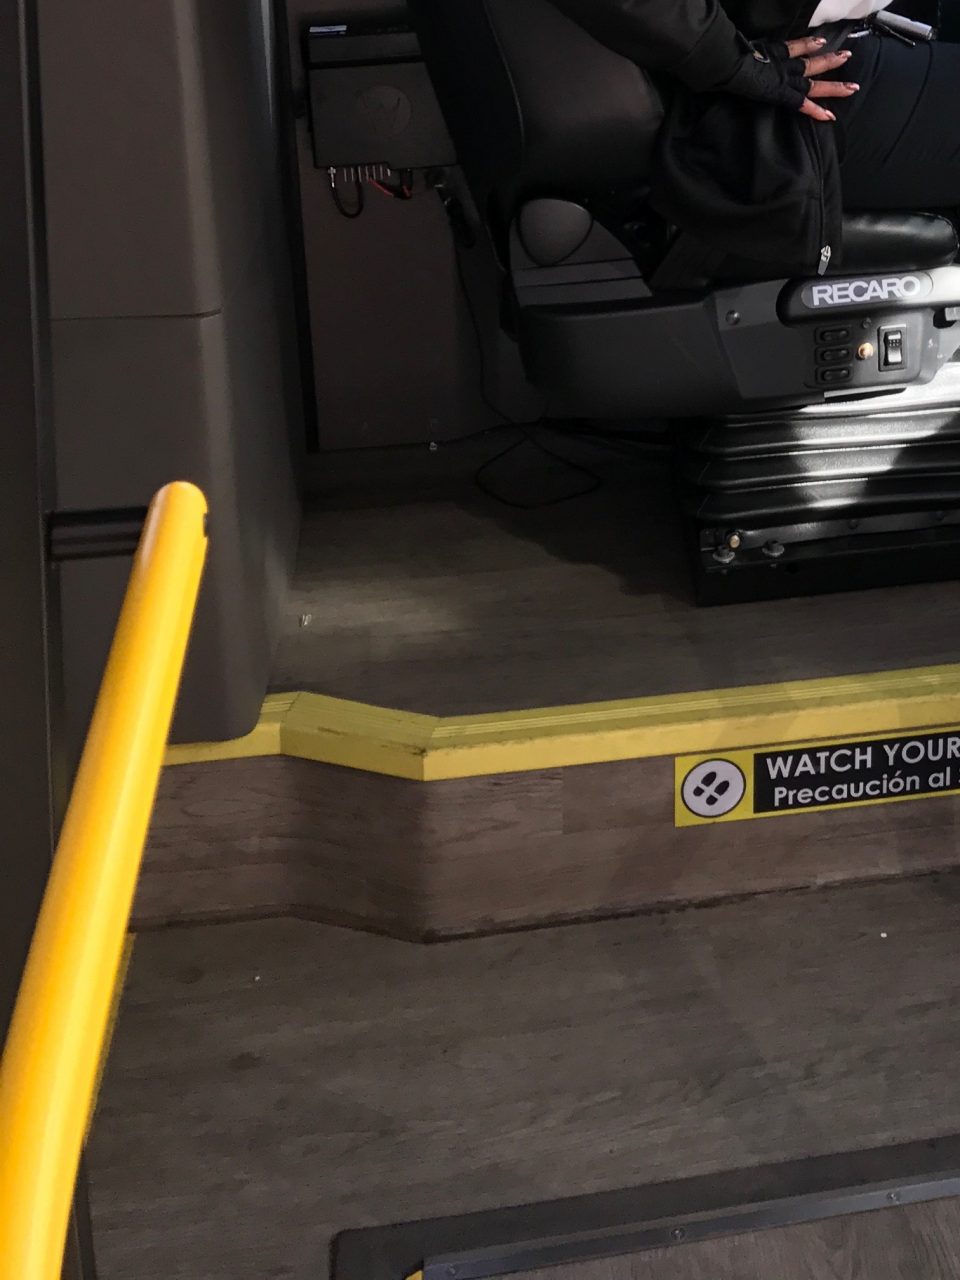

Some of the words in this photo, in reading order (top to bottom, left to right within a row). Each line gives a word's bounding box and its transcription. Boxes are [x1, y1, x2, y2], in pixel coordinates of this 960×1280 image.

[812, 276, 921, 306] RECARO
[766, 746, 873, 779] WATCH
[774, 771, 920, 807] Precaución
[928, 765, 951, 789] al
